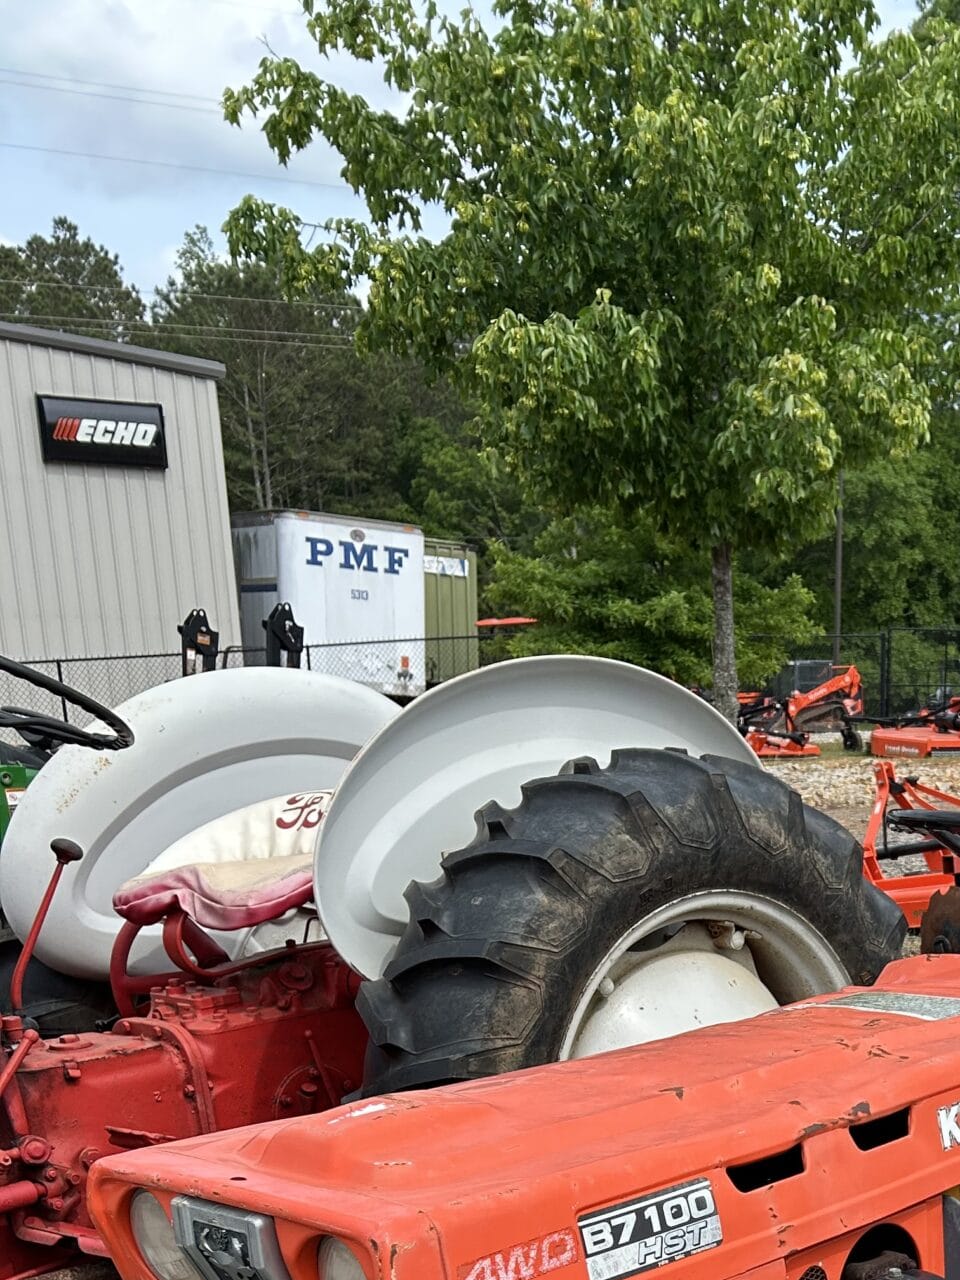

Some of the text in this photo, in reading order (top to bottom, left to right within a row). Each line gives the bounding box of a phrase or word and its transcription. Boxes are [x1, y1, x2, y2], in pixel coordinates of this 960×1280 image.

[76, 418, 157, 447] ECHO
[305, 536, 409, 575] PMF
[276, 791, 333, 832] Fo
[581, 1188, 715, 1255] B7100
[638, 1220, 707, 1265] HST
